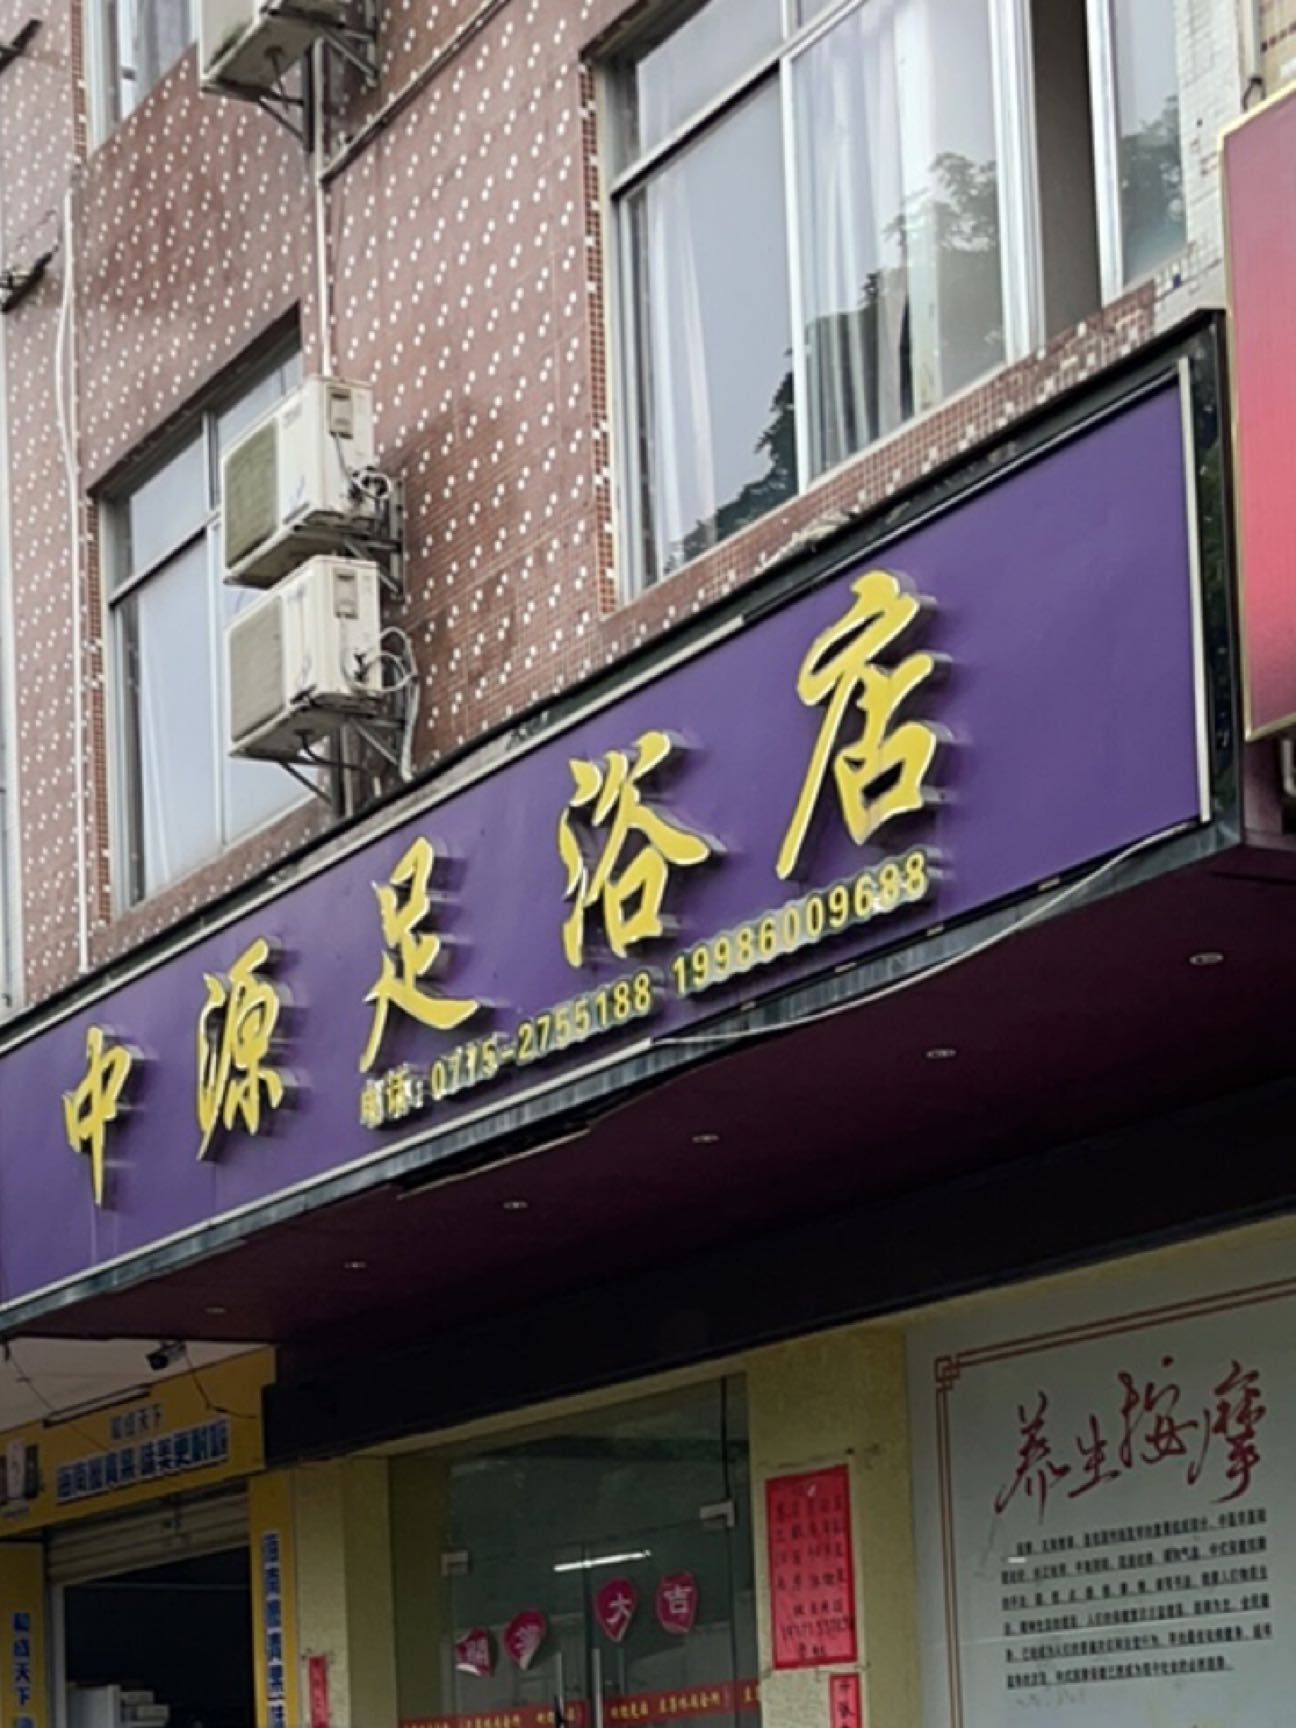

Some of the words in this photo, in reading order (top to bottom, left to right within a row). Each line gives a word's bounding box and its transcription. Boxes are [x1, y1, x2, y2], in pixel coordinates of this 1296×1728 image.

[63, 570, 942, 1208] 中源足浴店
[671, 850, 930, 994] 19986009688
[993, 1356, 1268, 1524] 养生按摩
